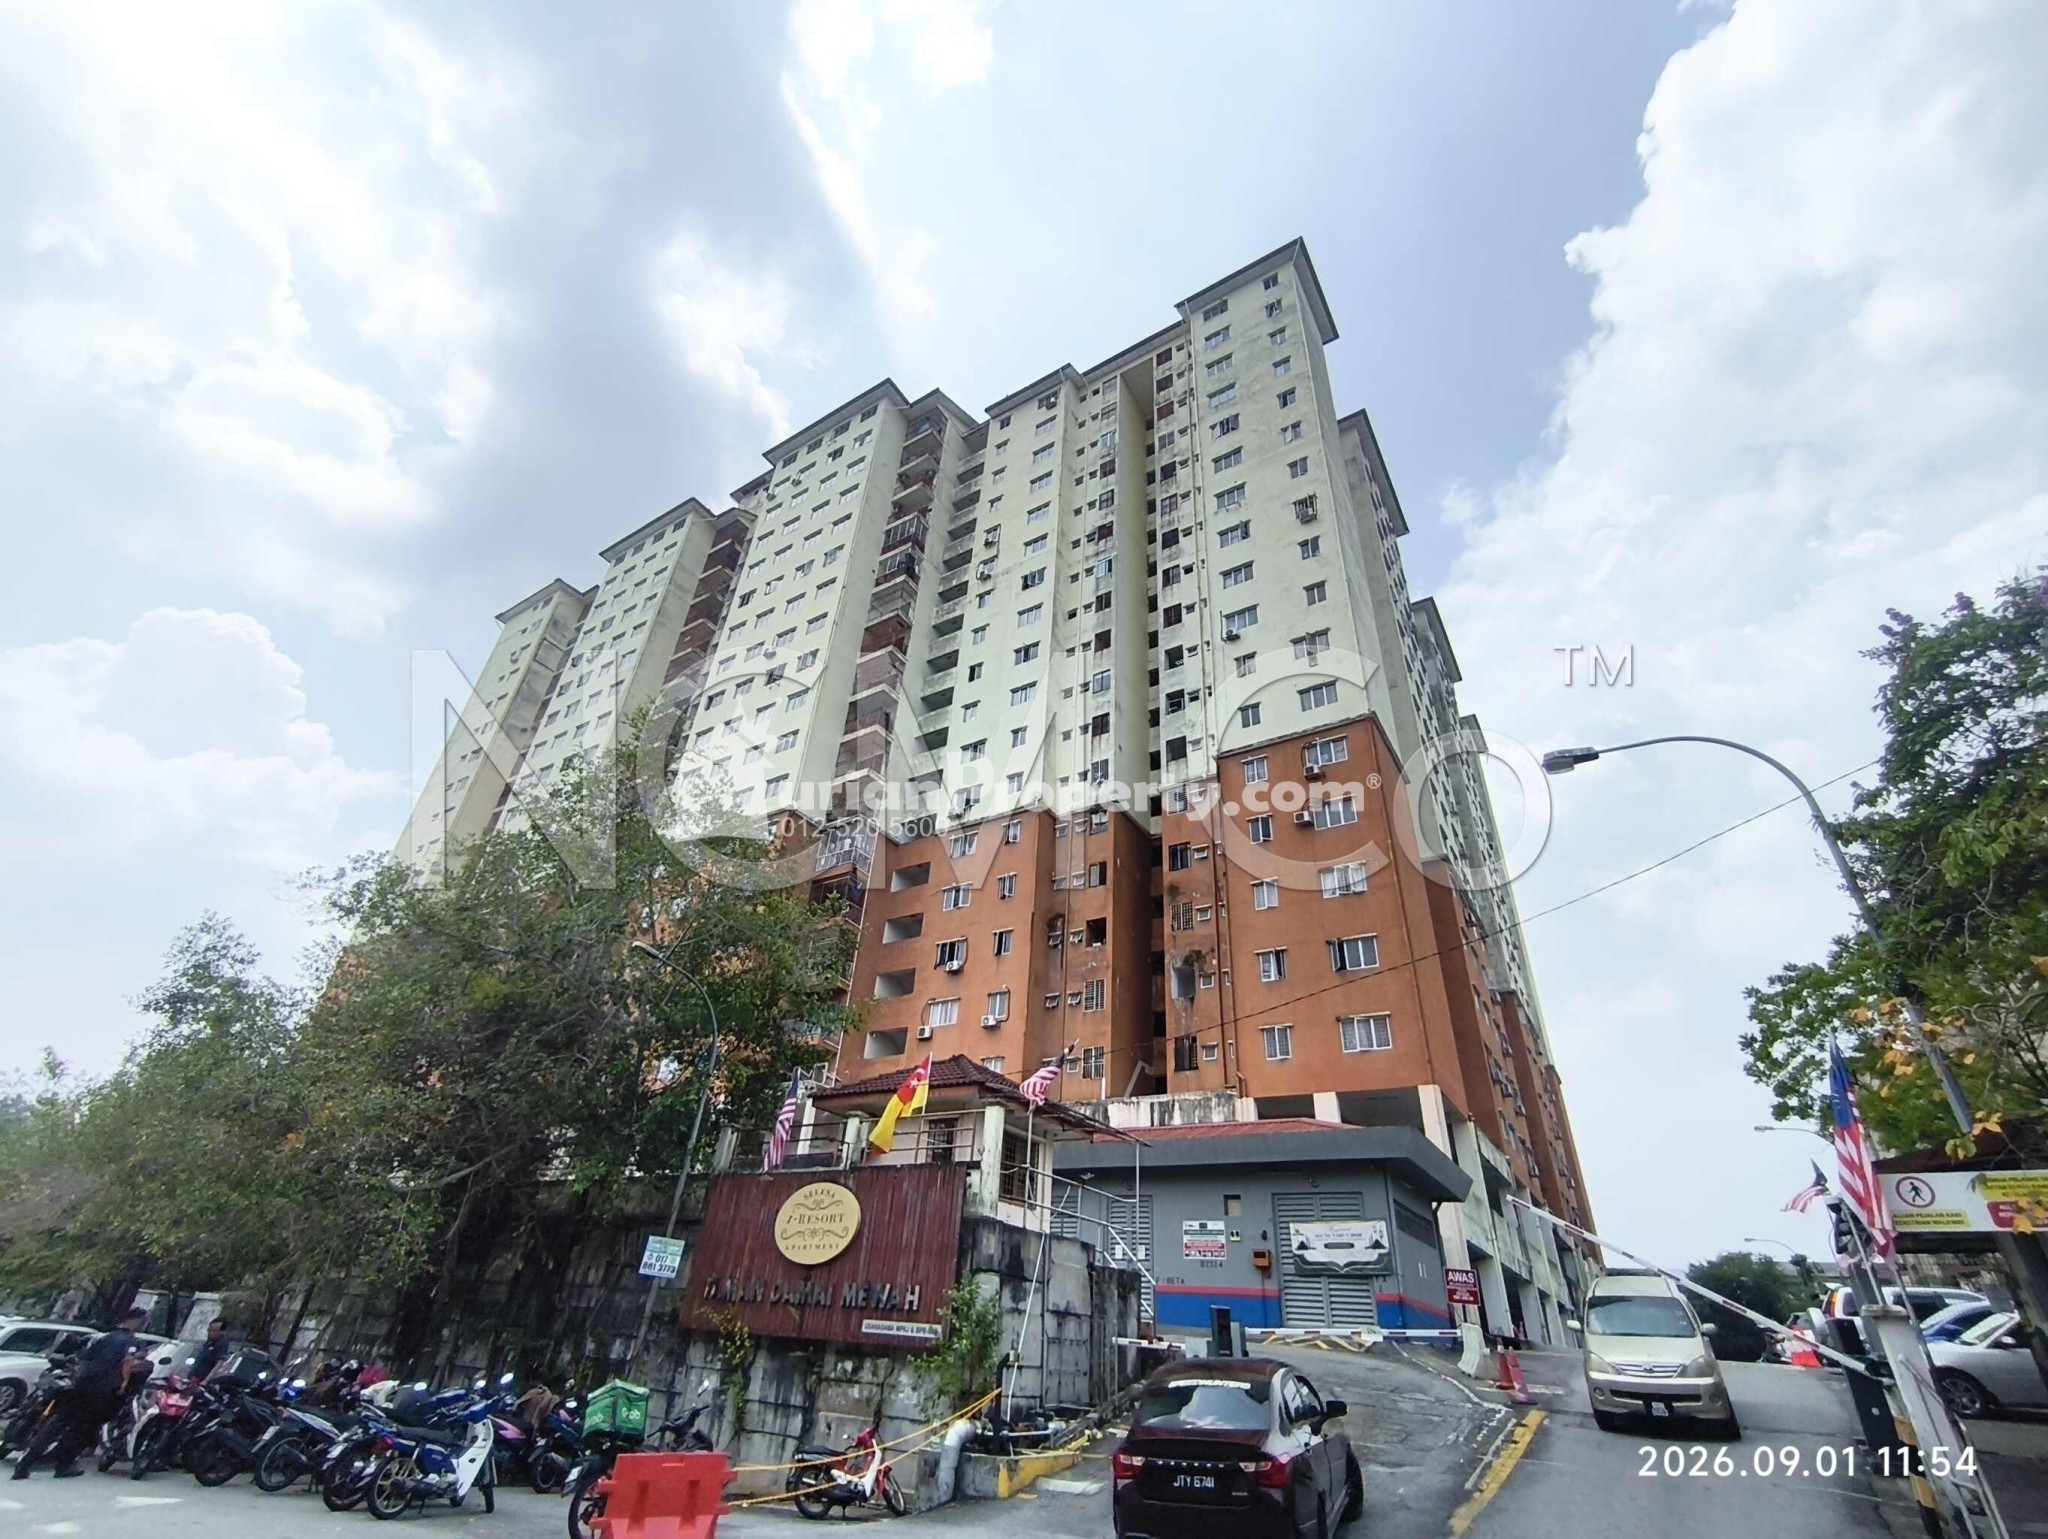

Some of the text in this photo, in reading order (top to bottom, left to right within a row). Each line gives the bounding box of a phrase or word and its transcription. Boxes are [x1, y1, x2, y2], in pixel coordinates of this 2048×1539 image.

[1448, 1270, 1475, 1284] AWAS
[1173, 1475, 1214, 1488] JTY 6741
